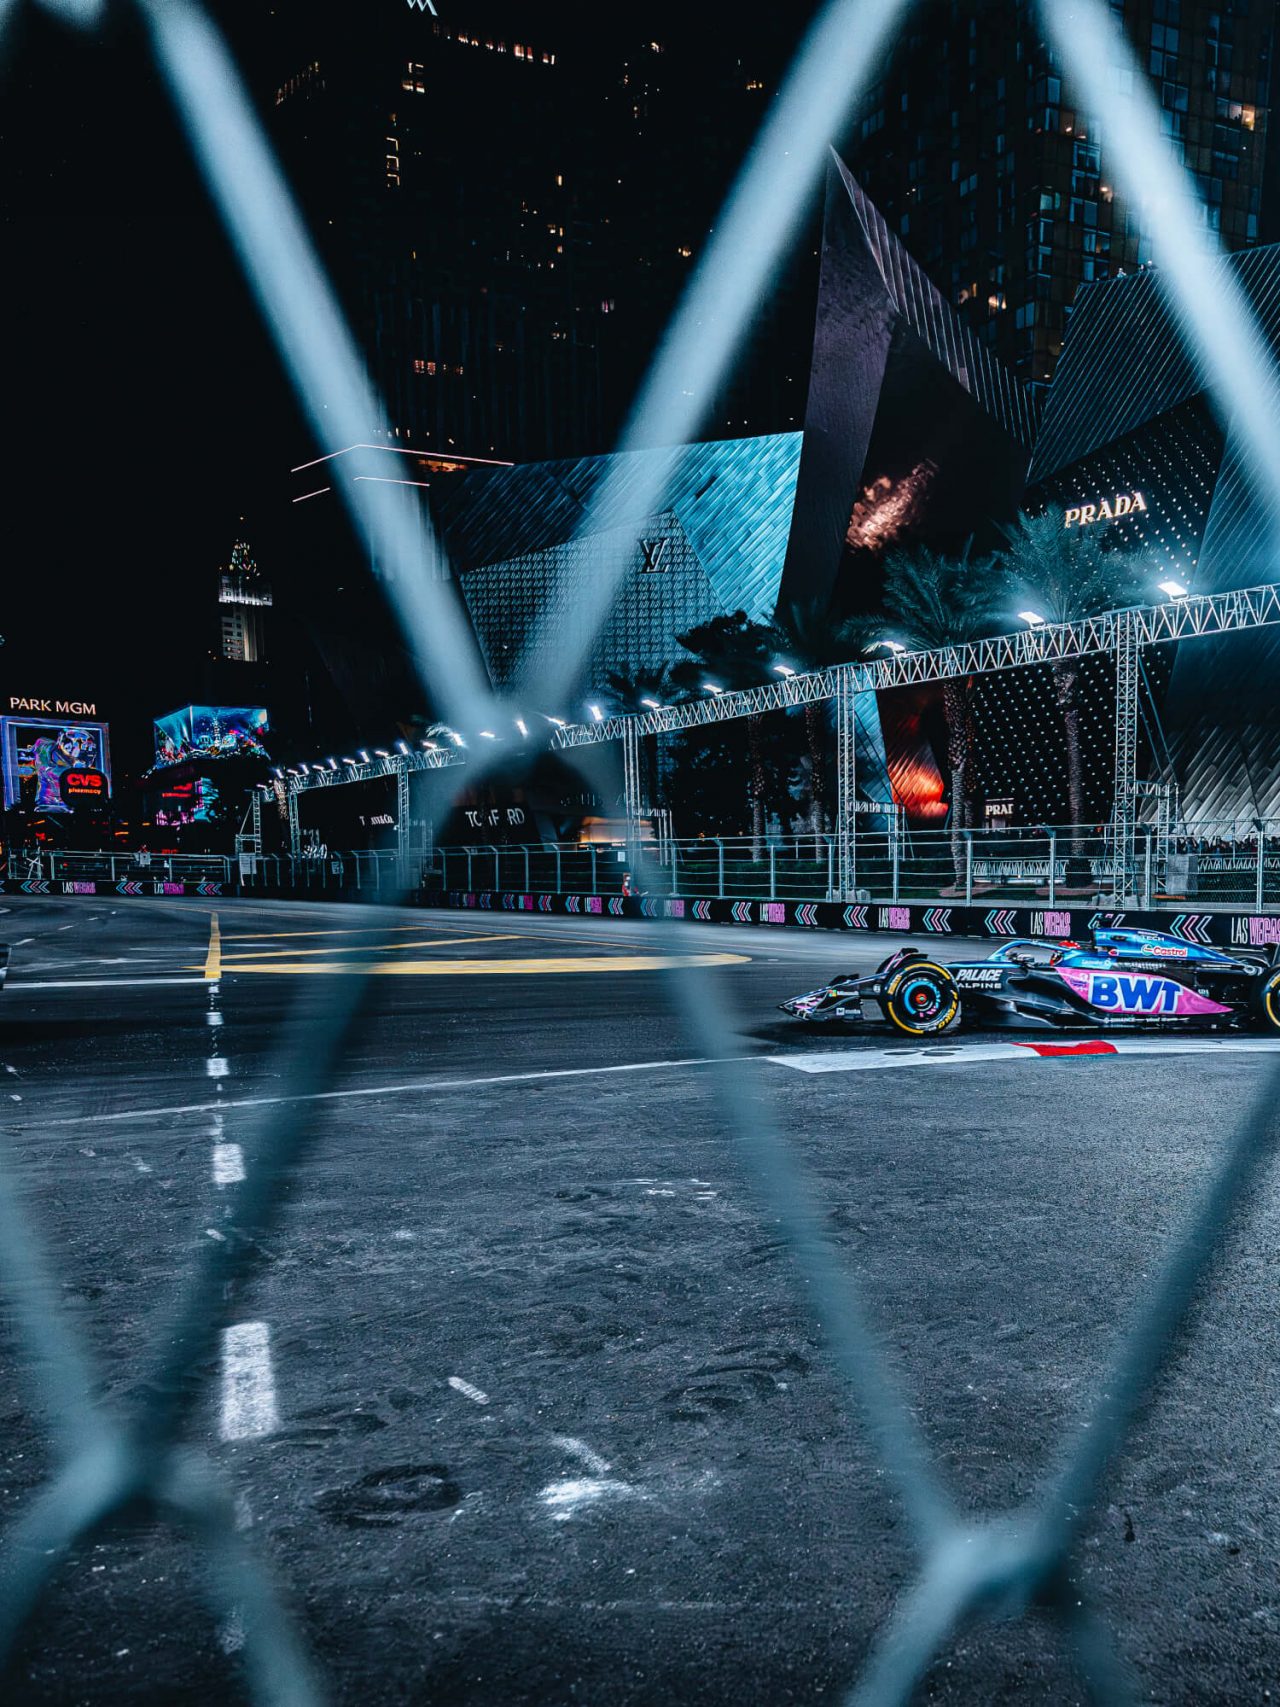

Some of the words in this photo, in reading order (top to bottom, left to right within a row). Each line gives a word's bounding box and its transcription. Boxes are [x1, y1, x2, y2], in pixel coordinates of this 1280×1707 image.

[1064, 491, 1147, 529] PRADA
[10, 697, 52, 712] PARK
[55, 700, 96, 715] MGM
[67, 773, 102, 787] CVS
[490, 807, 525, 826] FRD
[62, 881, 74, 893] LAS
[879, 907, 889, 928] LAS
[1030, 911, 1044, 935] LAS
[1044, 911, 1071, 937] VEGAS
[1231, 917, 1248, 944] LAS
[1153, 946, 1188, 957] Castrol
[956, 968, 1003, 981] PALACE
[1090, 975, 1182, 1012] BWT
